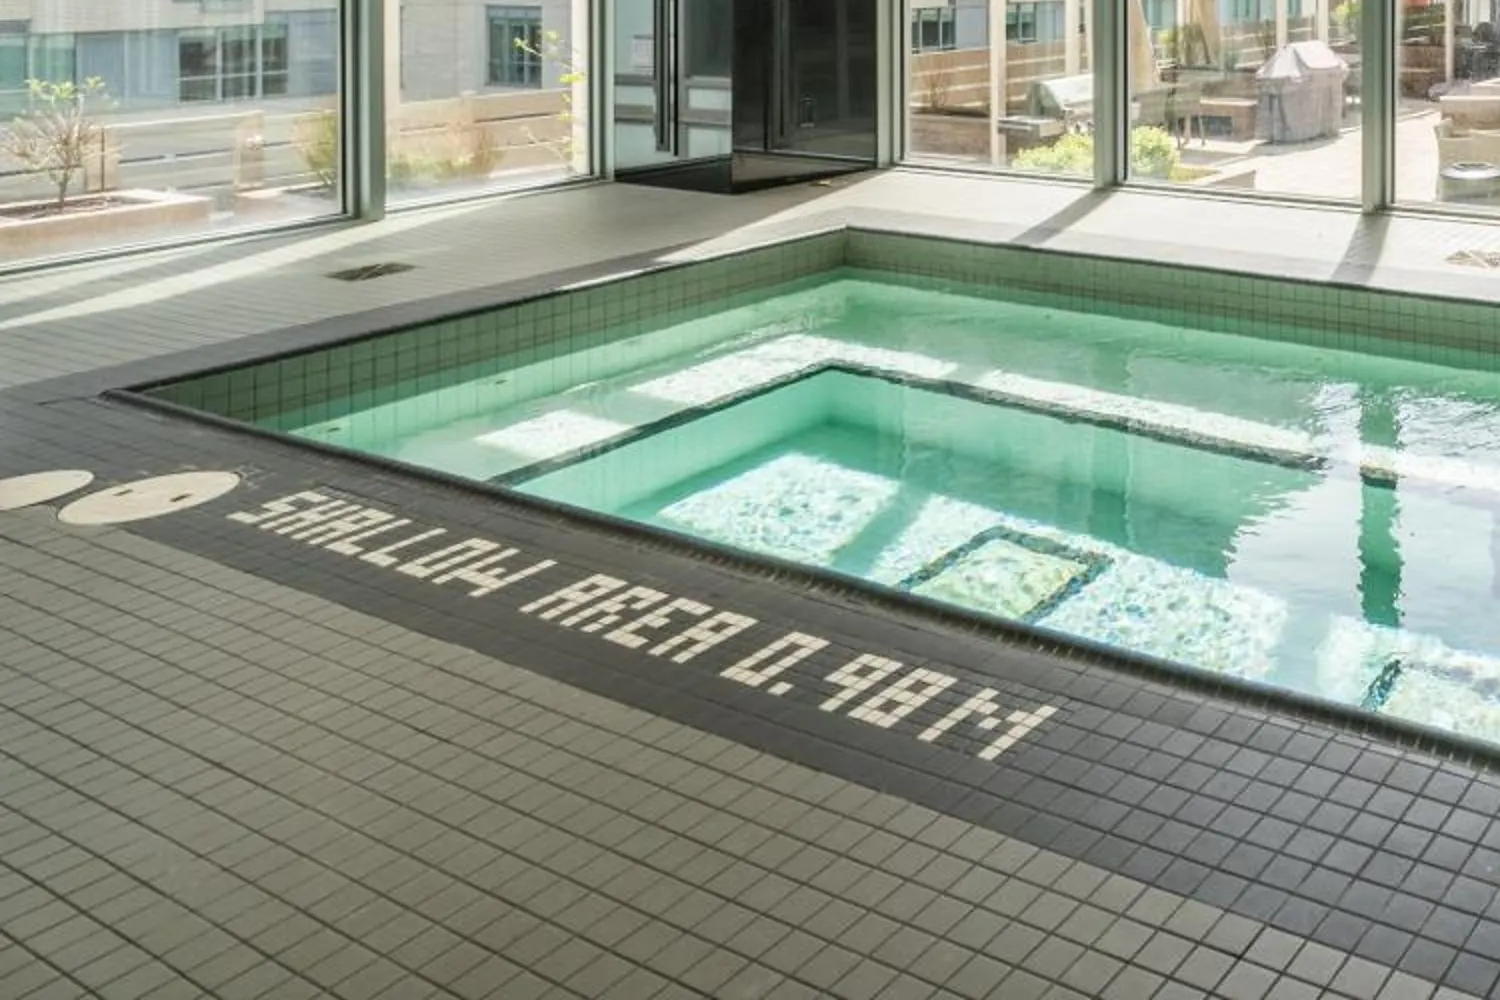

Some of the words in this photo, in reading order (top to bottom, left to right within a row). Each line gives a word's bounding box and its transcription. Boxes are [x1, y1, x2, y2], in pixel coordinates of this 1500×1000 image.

[226, 490, 558, 598] SHALLOW
[519, 573, 758, 664] AREA
[719, 631, 958, 729] 0.98
